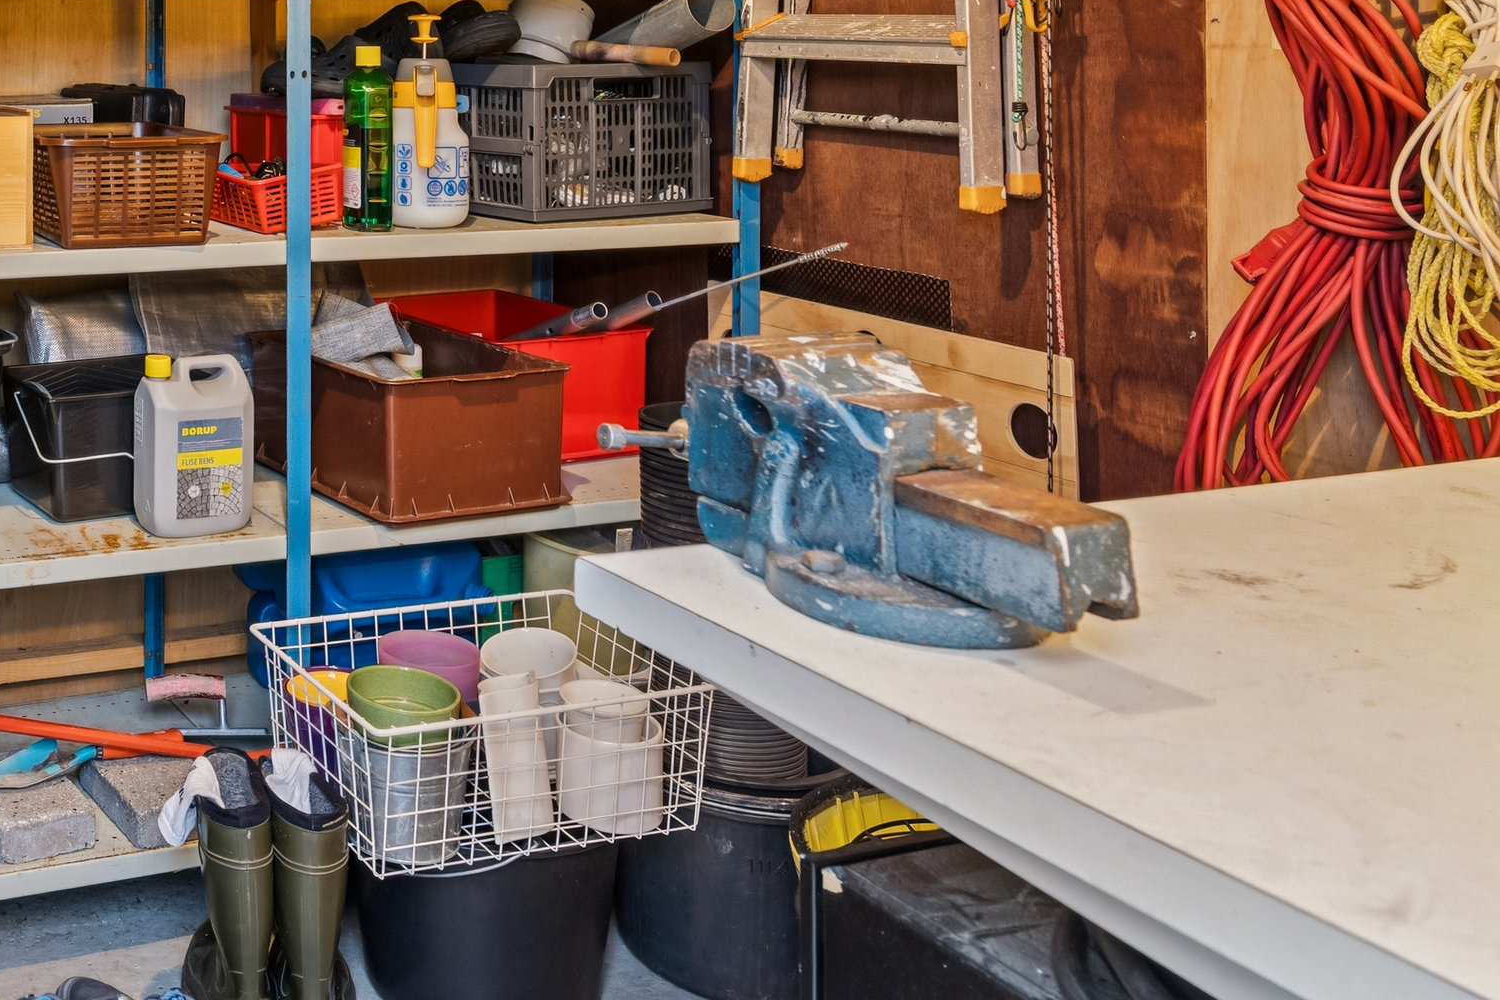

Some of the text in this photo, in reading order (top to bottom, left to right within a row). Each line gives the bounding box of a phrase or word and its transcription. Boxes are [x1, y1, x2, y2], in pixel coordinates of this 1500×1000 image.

[63, 116, 87, 124] X135
[181, 426, 217, 436] BORUP
[199, 457, 214, 465] RENS
